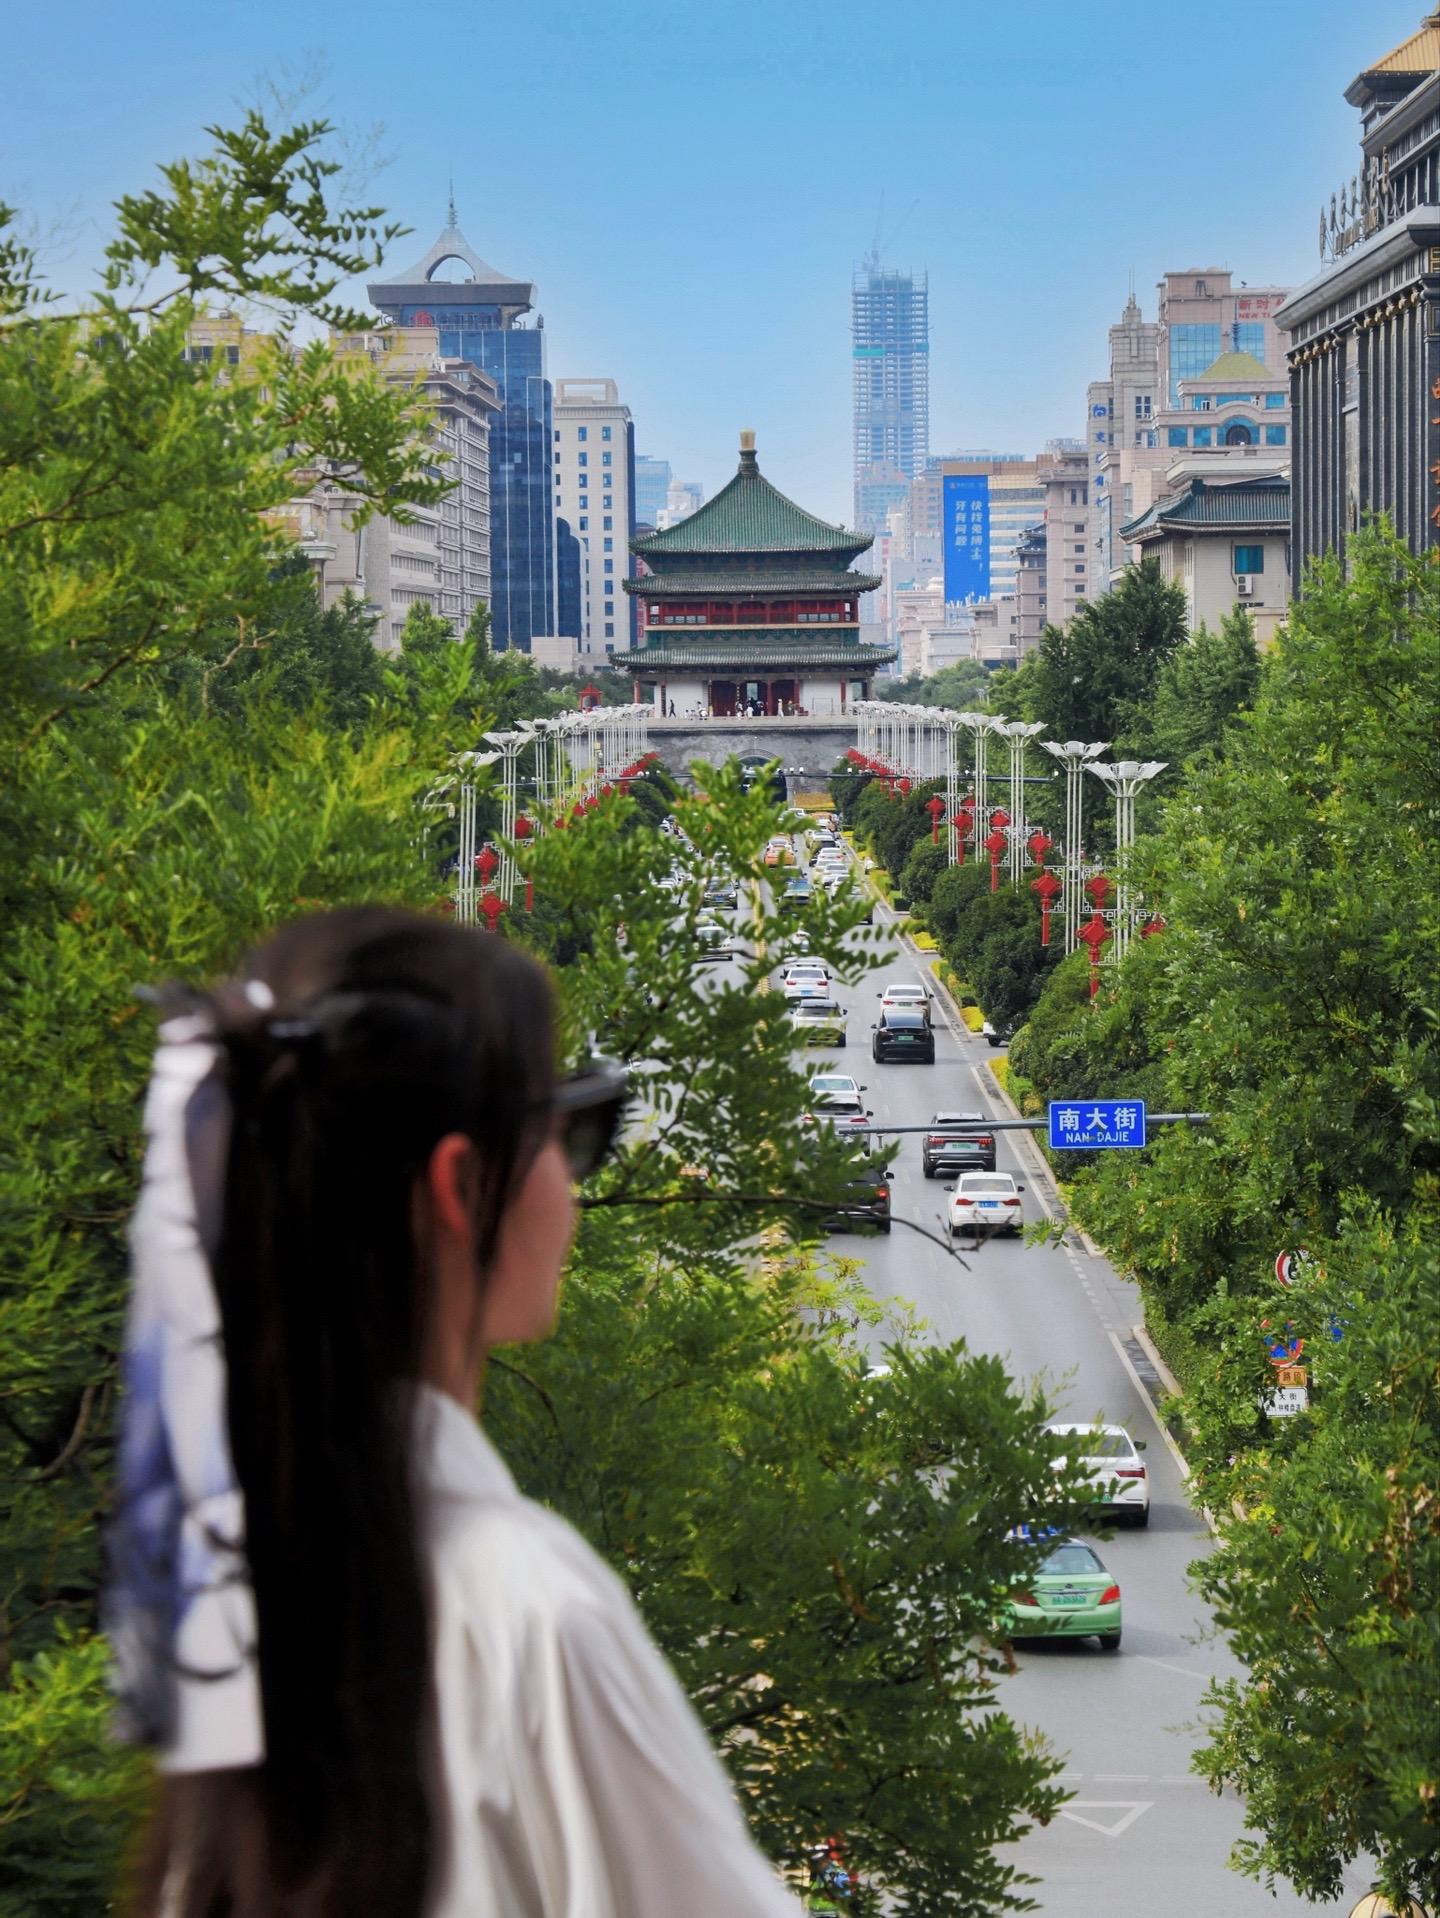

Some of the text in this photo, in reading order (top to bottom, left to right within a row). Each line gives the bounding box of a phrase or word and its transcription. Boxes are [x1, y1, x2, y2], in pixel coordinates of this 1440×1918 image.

[1057, 1107, 1137, 1131] 南大街
[1066, 1131, 1129, 1143] NAN DAJIE
